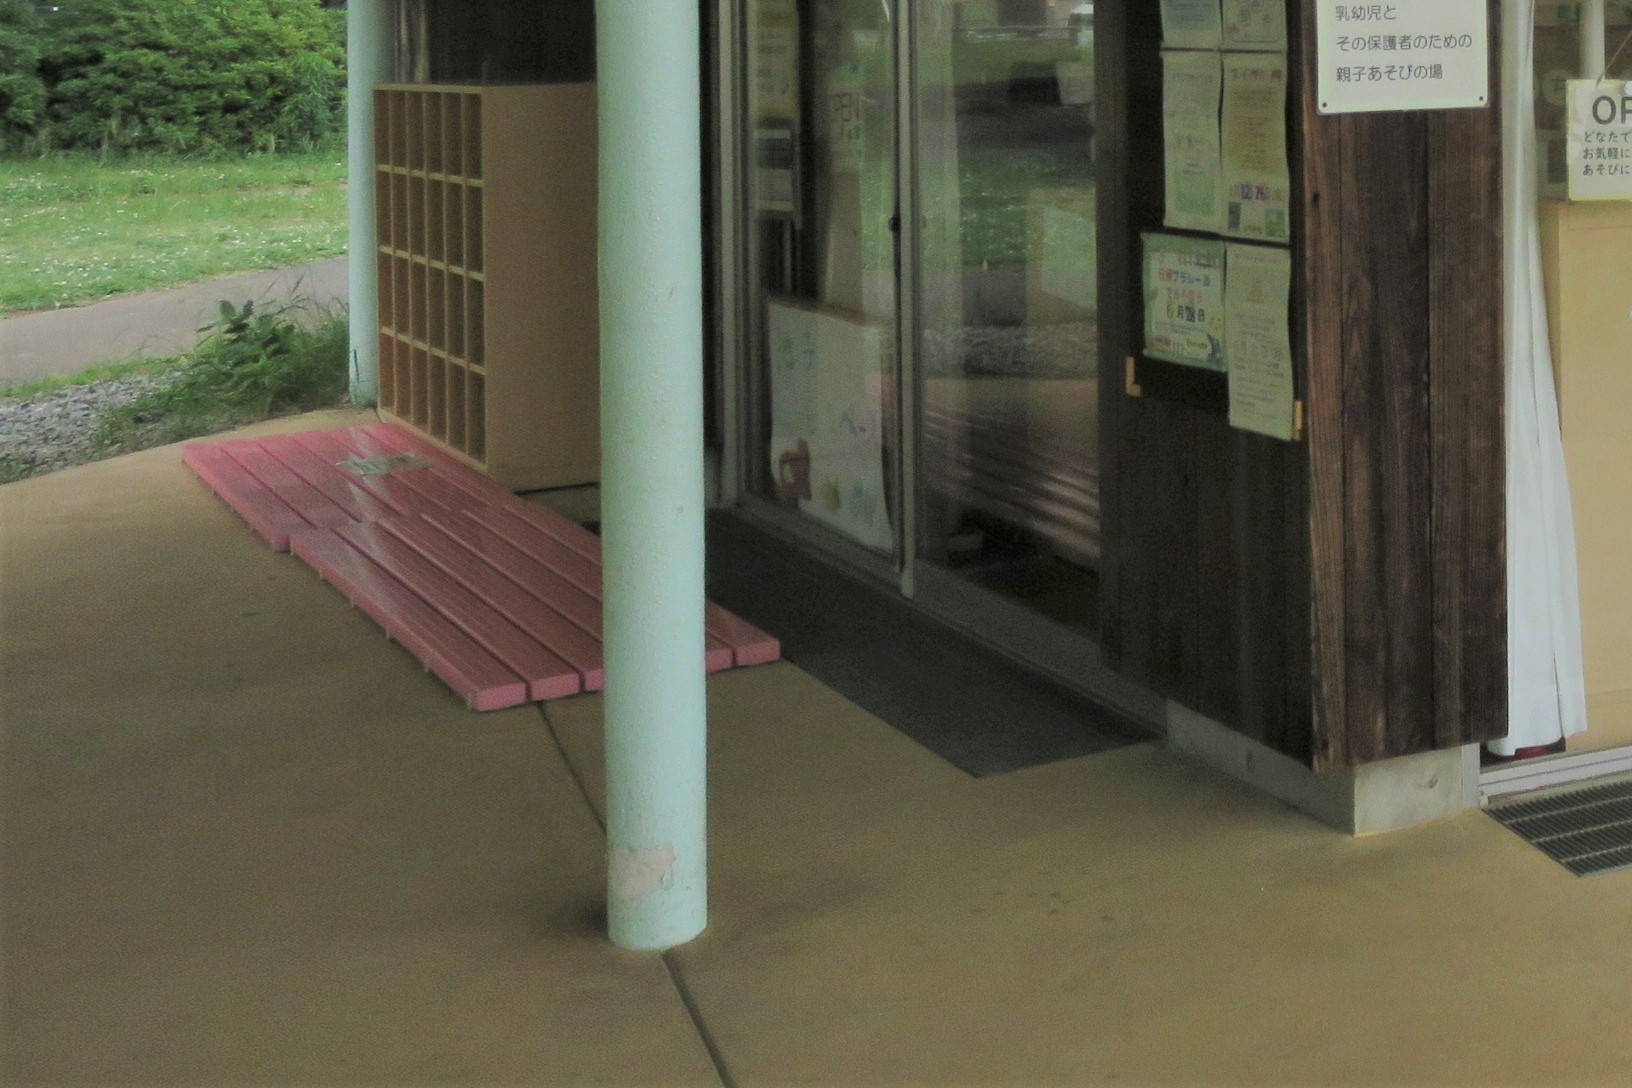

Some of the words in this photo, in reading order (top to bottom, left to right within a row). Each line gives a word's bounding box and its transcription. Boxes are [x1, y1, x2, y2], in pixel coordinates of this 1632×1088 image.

[1335, 5, 1398, 22] 乳幼児と
[1335, 34, 1473, 51] その保護者のための
[1335, 64, 1443, 83] 親子あそびの場
[1582, 147, 1631, 160] お気軽に
